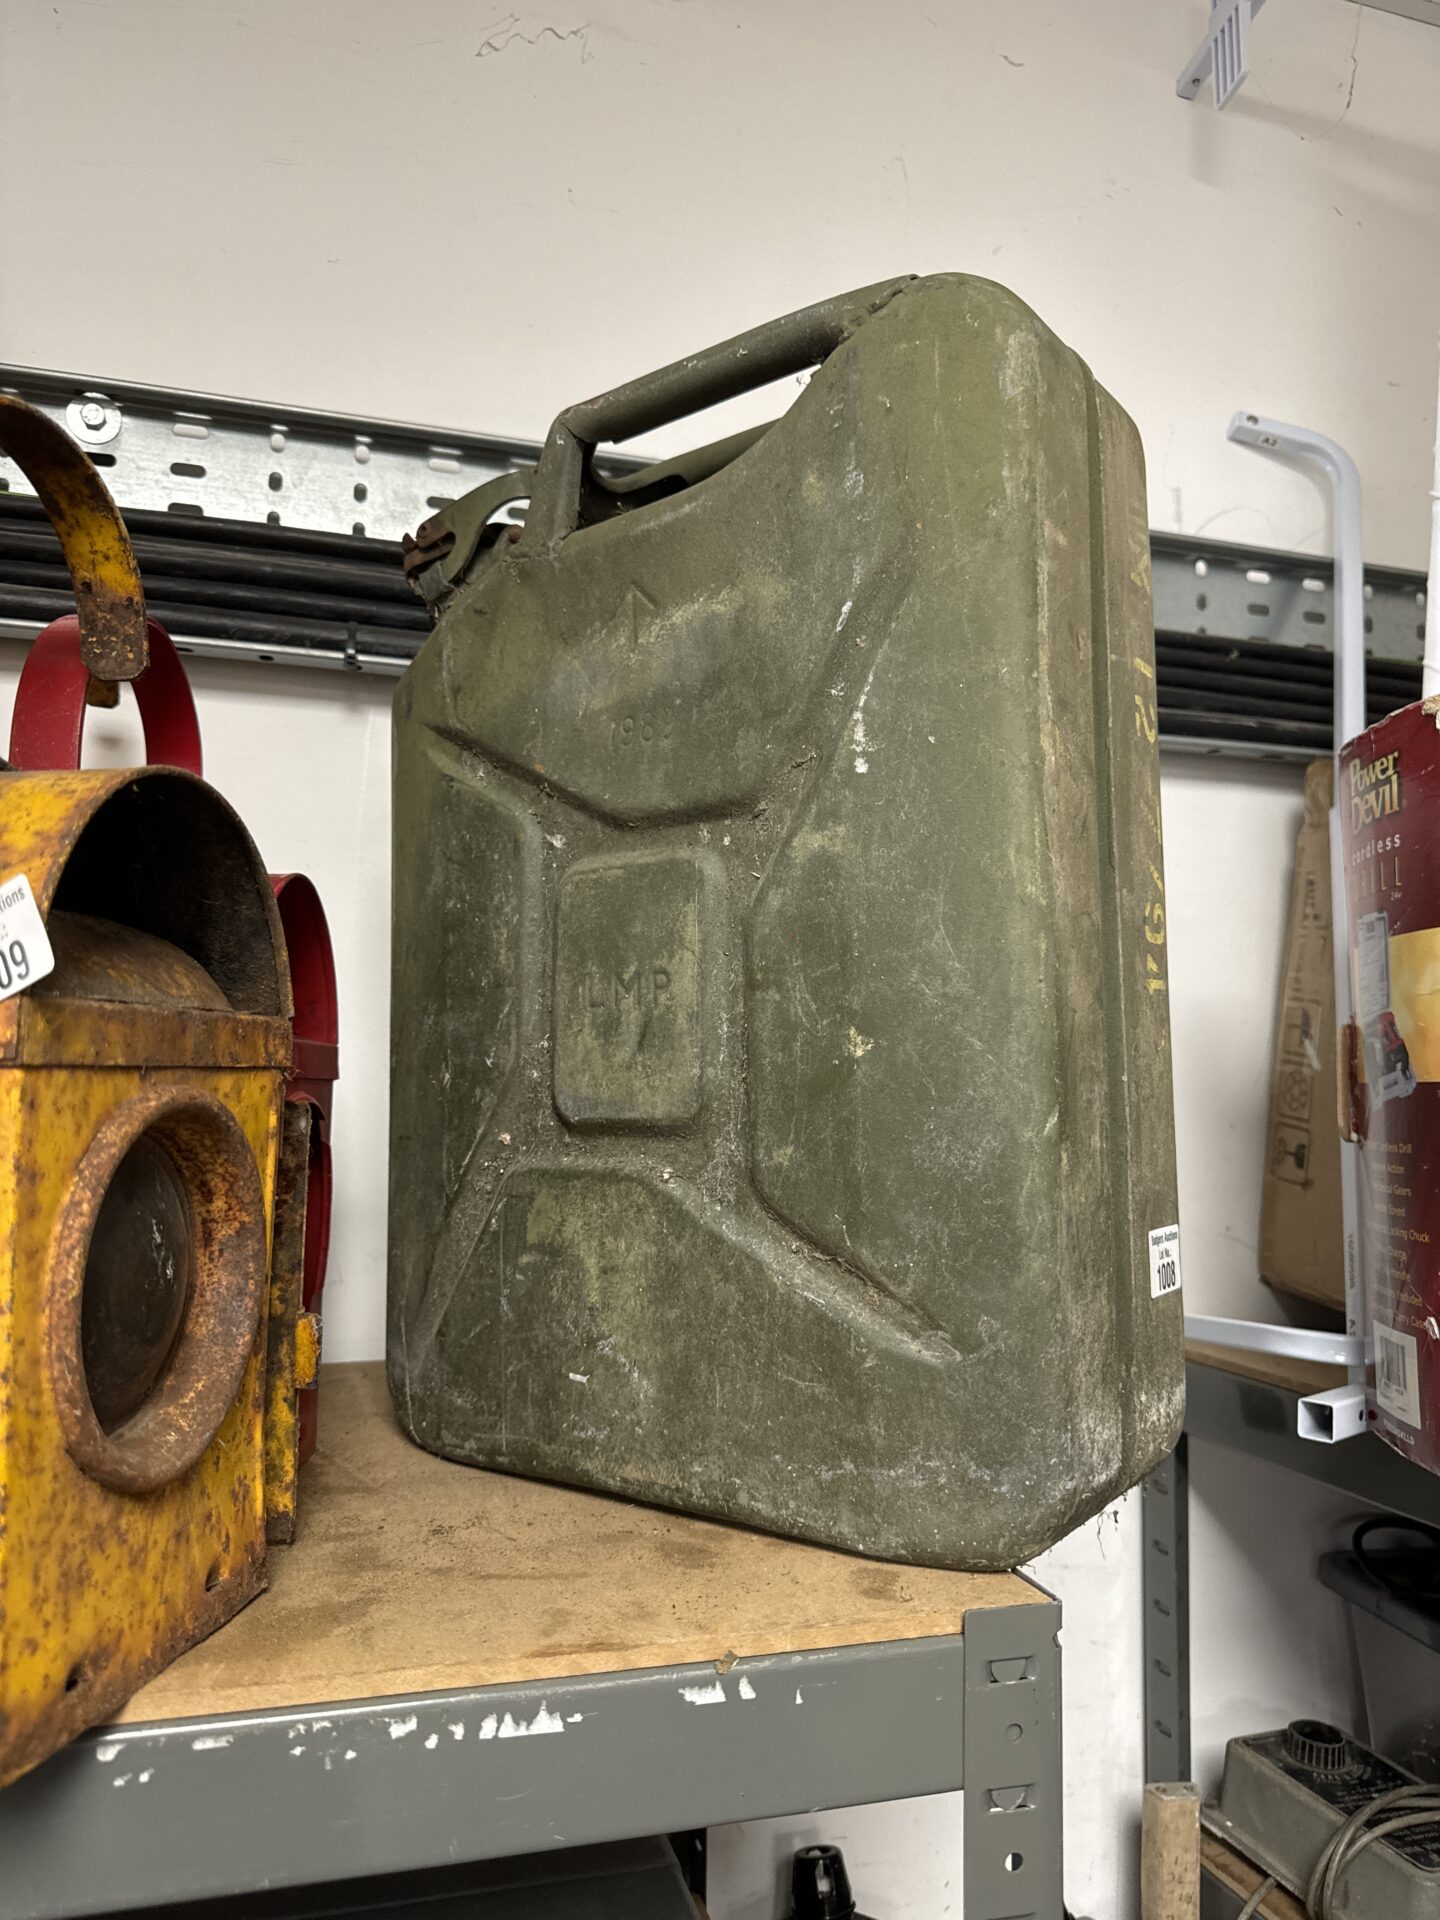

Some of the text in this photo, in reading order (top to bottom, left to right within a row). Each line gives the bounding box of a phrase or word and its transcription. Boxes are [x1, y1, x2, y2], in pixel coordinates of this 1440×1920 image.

[1350, 751, 1399, 797] Power
[1352, 834, 1401, 866] cordless
[1408, 1229, 1430, 1243] Chuck
[1157, 1260, 1176, 1291] 1008
